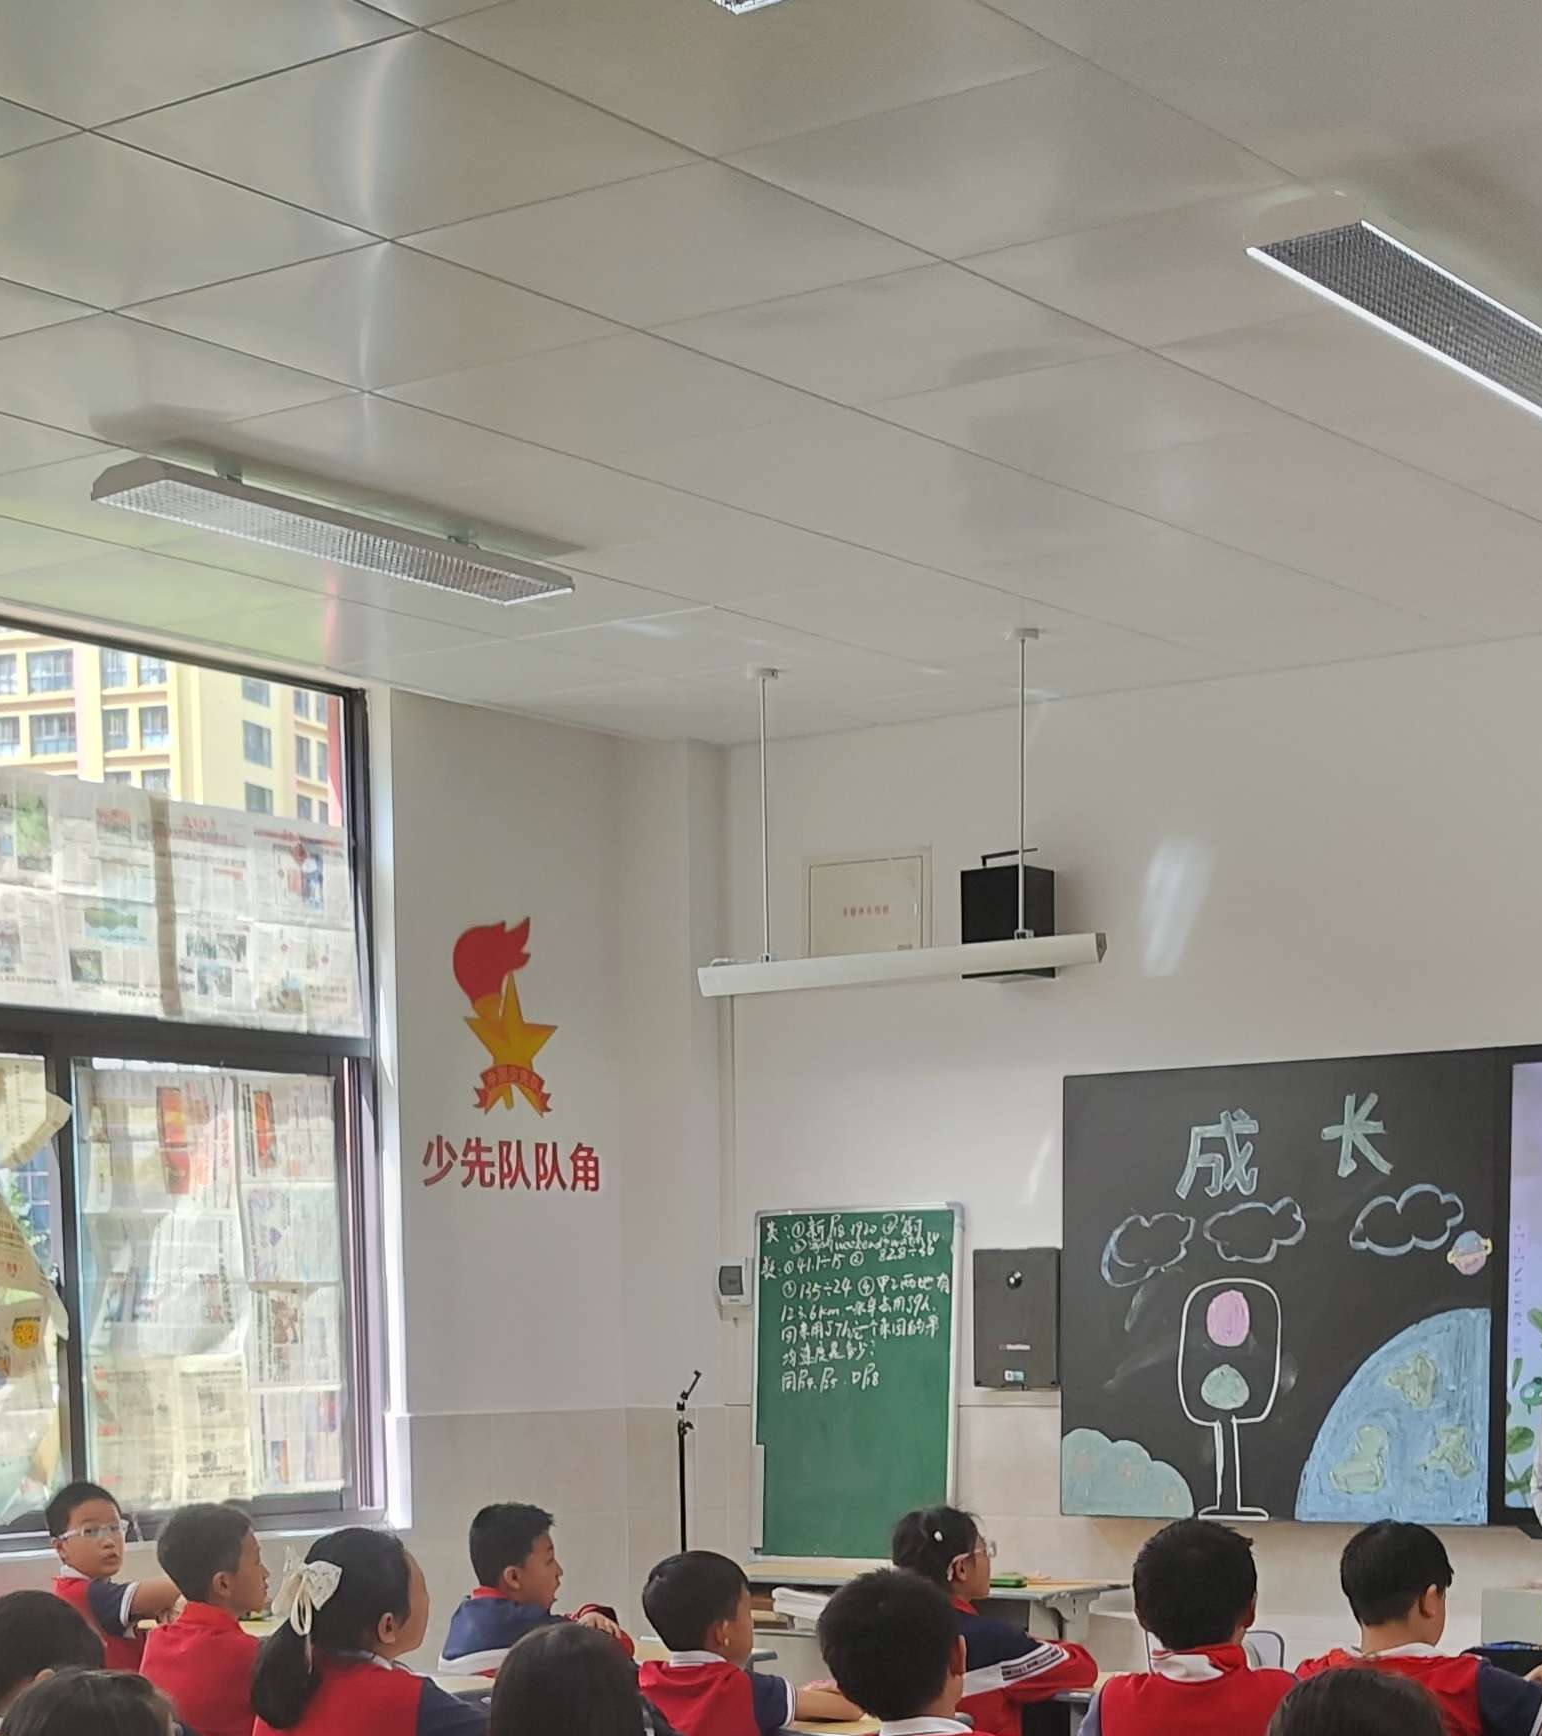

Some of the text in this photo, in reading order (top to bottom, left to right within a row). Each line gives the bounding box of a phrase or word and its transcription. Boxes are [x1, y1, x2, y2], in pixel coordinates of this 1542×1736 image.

[422, 1135, 601, 1192] 少先队队角
